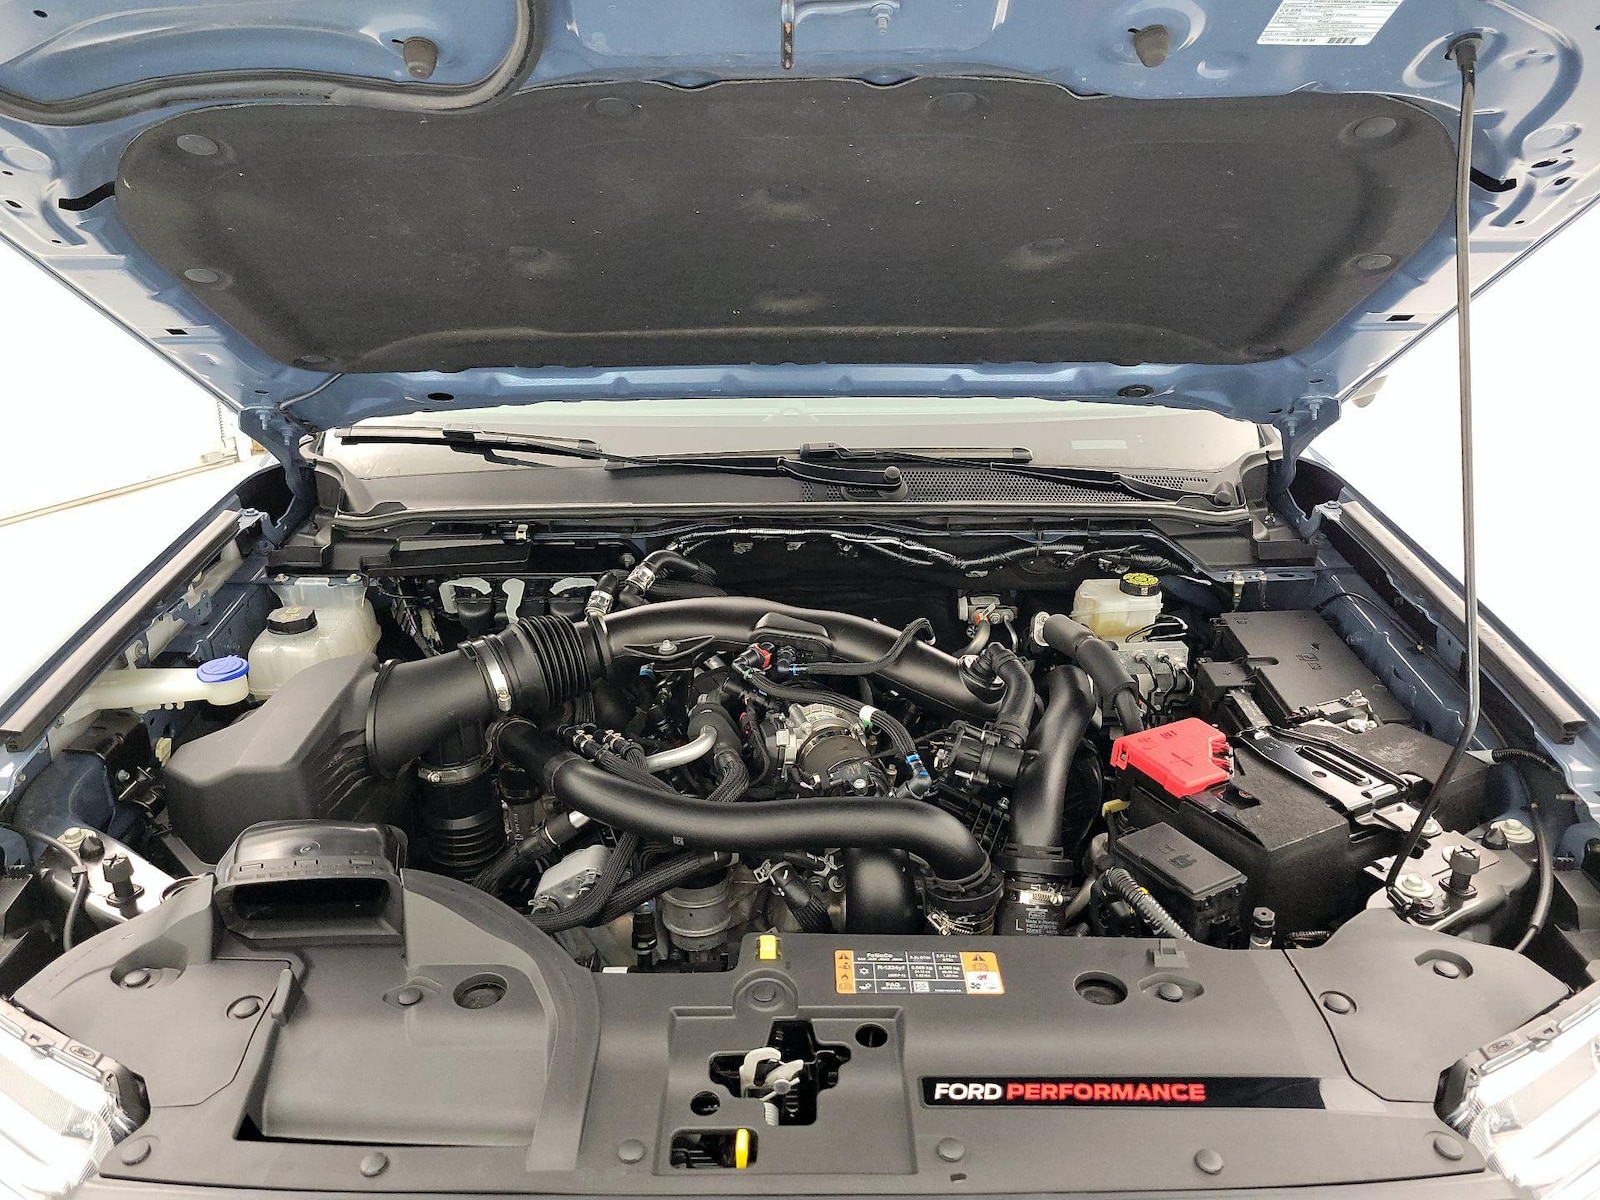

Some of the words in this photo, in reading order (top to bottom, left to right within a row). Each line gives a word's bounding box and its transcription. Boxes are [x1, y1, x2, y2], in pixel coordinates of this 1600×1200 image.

[1015, 918, 1024, 931] L
[934, 1082, 1003, 1101] FORD
[1006, 1083, 1206, 1102] PERFORMANCE
